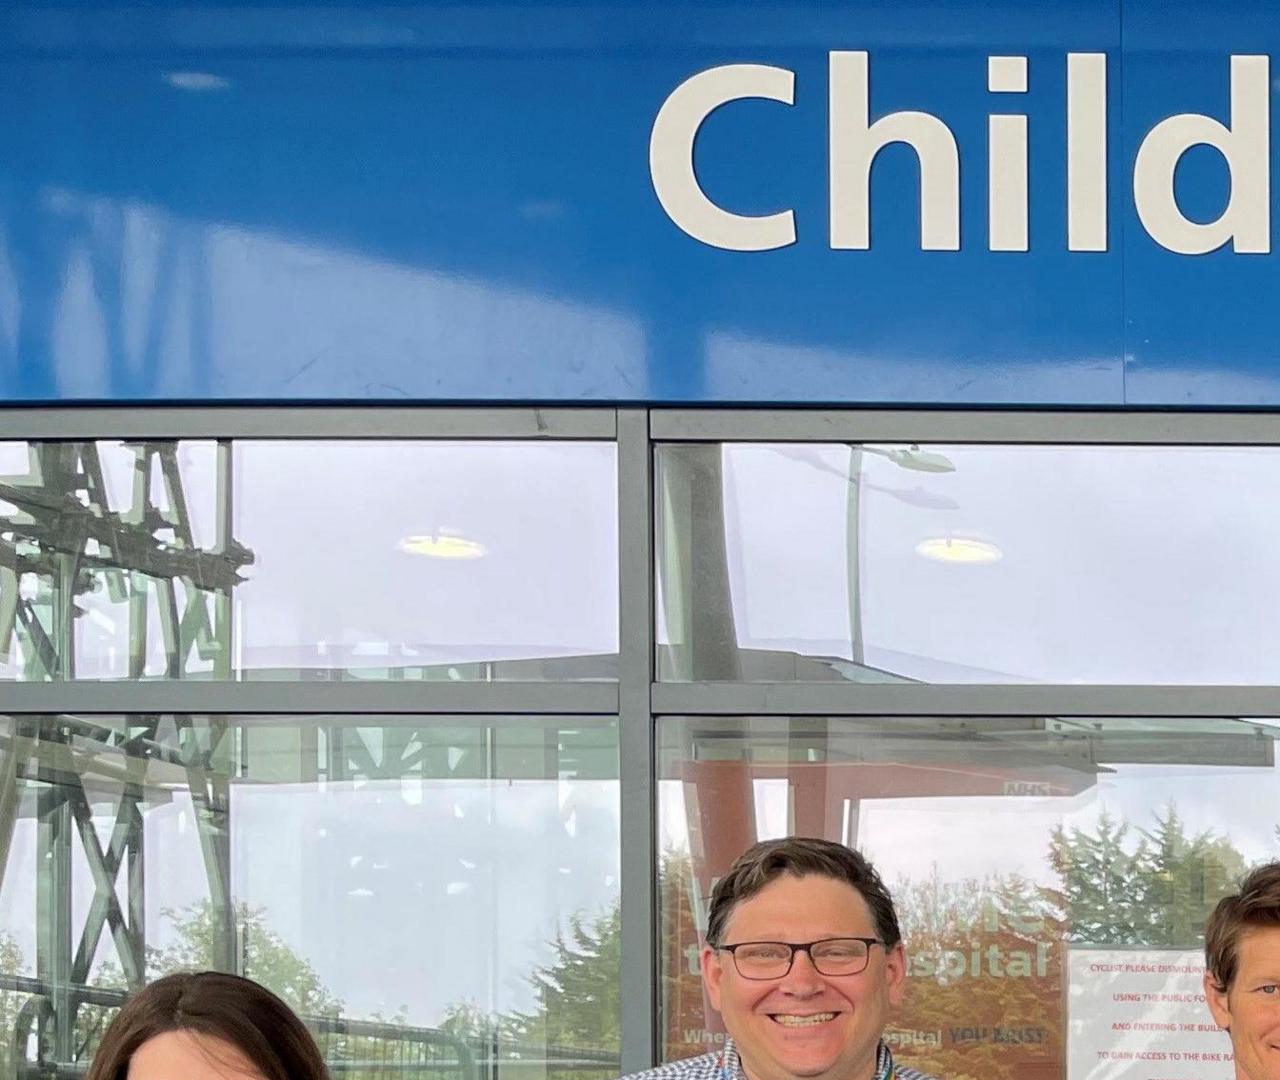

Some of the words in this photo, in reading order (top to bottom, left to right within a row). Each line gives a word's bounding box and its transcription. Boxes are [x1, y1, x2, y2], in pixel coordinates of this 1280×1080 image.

[906, 941, 1048, 987] spital
[1125, 964, 1157, 973] PLEASE
[1112, 993, 1141, 1002] USING
[1142, 993, 1159, 1002] THE
[1161, 994, 1192, 1003] PUBLIC
[1193, 994, 1206, 1003] FO
[1111, 1023, 1131, 1031] AND
[1133, 1023, 1177, 1031] ENTERING
[1179, 1024, 1195, 1032] THE
[682, 1029, 729, 1044] Whe
[882, 1028, 942, 1046] ospital
[949, 1027, 987, 1043] YOU
[1098, 1051, 1110, 1060] TO
[1111, 1051, 1133, 1060] GAIN
[1135, 1052, 1167, 1061] ACCESS
[1169, 1052, 1181, 1061] TO
[1183, 1053, 1200, 1061] THE
[1201, 1053, 1222, 1062] BIKE
[1223, 1053, 1235, 1062] RA
